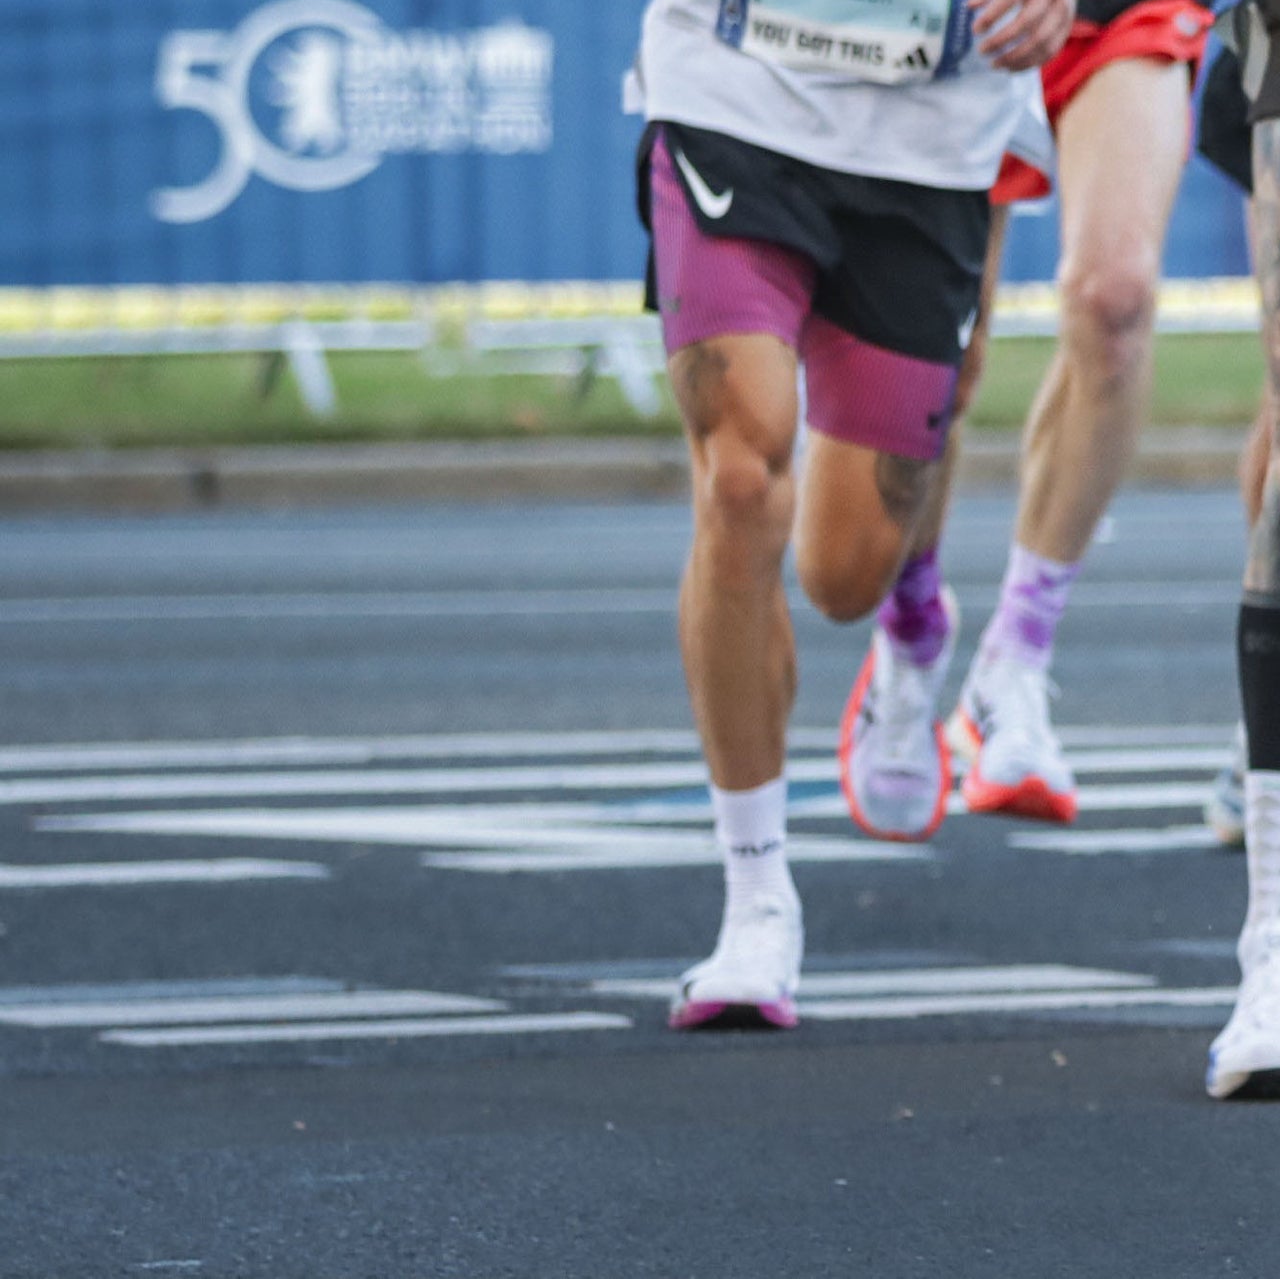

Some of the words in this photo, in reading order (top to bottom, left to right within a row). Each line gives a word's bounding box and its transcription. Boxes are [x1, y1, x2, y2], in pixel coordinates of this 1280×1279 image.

[753, 21, 791, 47] YOU
[797, 31, 834, 58] GOT
[840, 39, 884, 64] THIS
